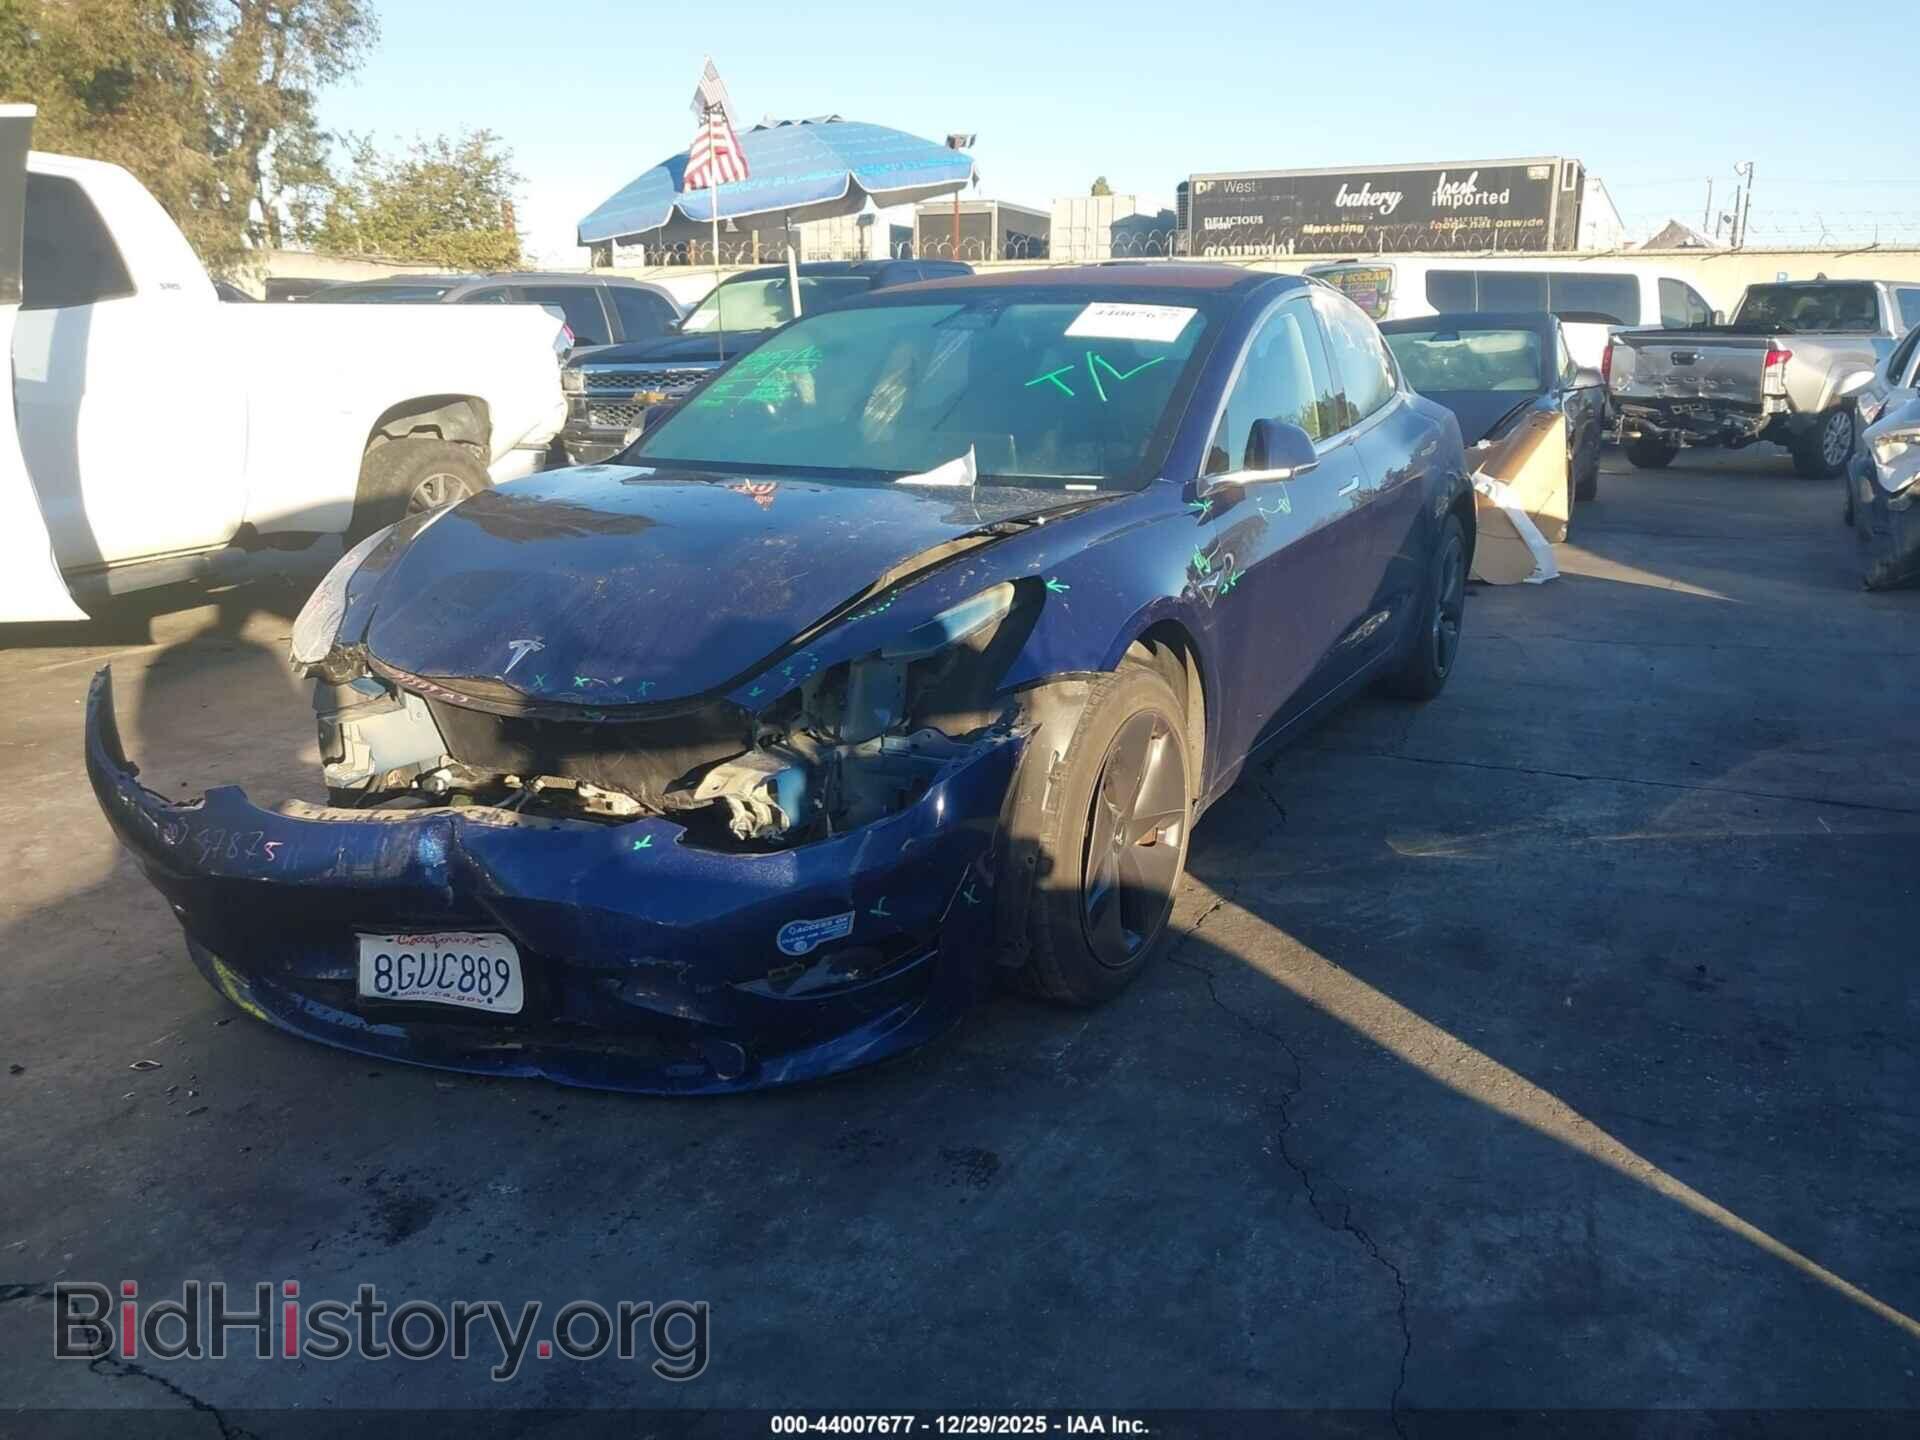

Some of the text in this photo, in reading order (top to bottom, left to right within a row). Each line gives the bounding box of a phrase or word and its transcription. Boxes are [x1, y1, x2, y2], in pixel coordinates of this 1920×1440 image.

[1224, 180, 1256, 193] West
[1335, 182, 1403, 215] bakery
[1431, 189, 1510, 209] imported
[1204, 215, 1264, 226] DELICIOUS
[1302, 222, 1365, 234] Marketing
[374, 953, 511, 998] 8GUC889
